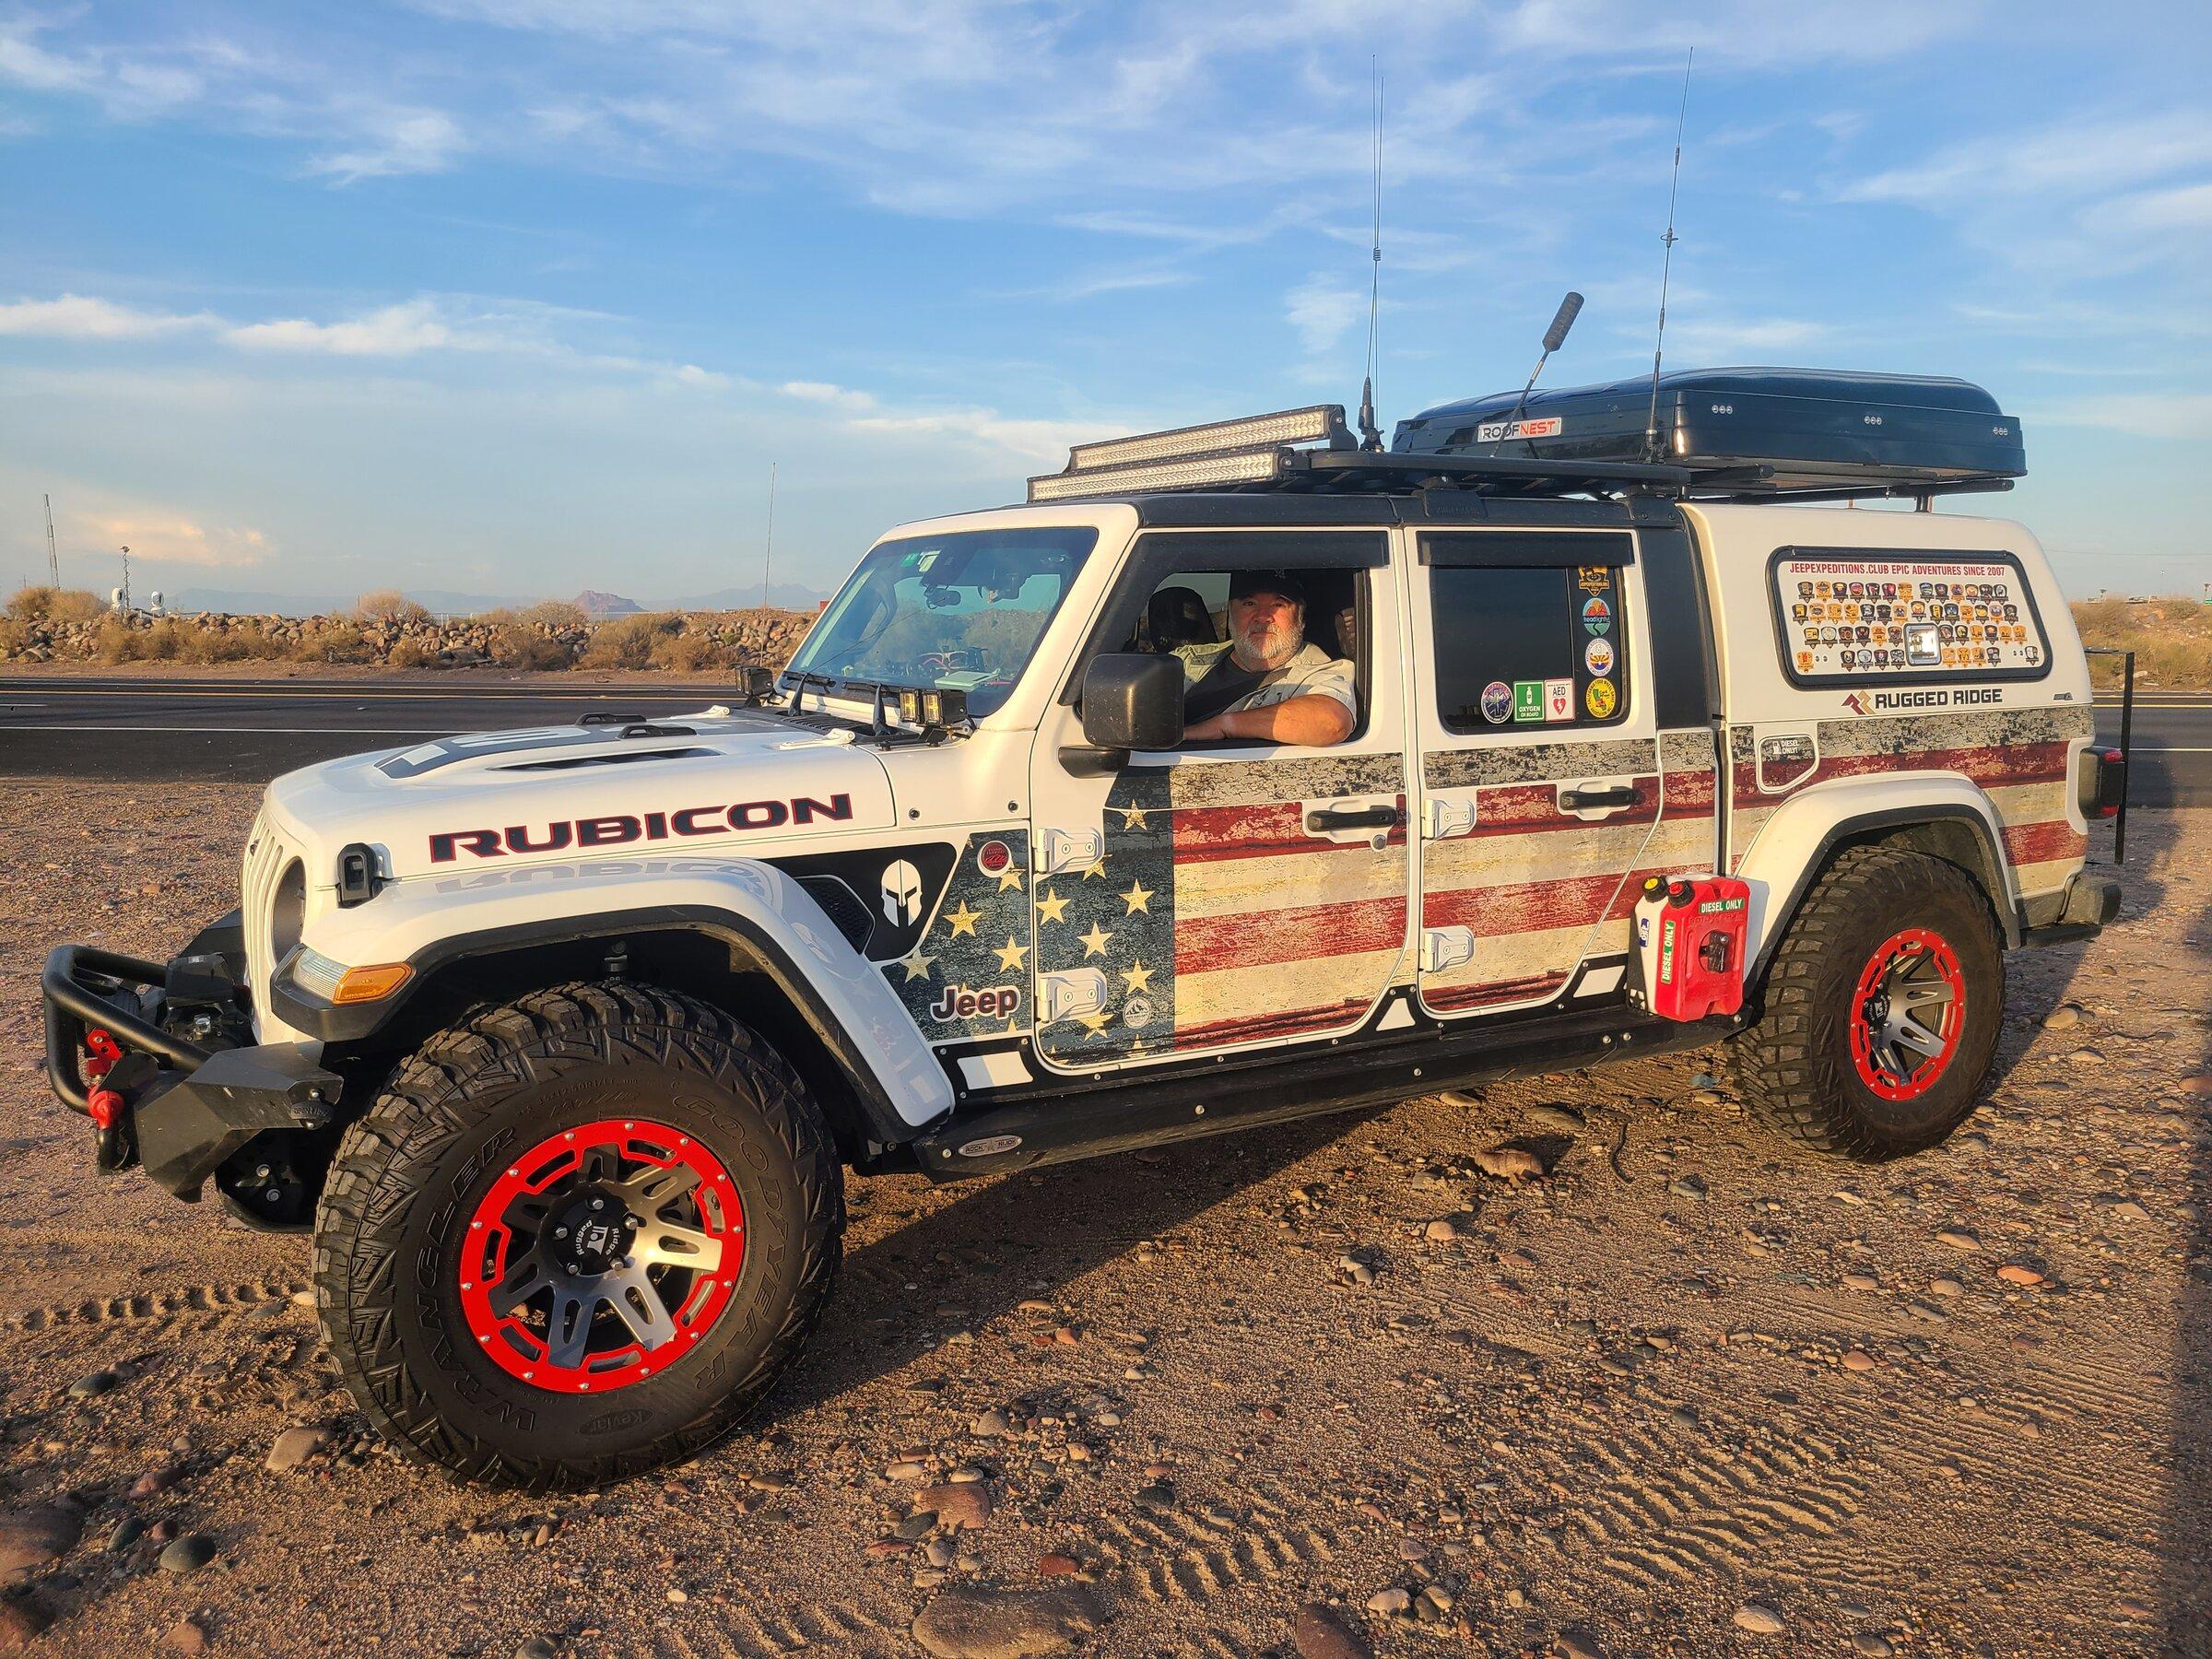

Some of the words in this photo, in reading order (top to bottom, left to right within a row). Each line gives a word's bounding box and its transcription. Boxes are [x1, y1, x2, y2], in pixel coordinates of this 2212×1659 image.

[1483, 421, 1555, 439] ROOFNEST
[1790, 563, 1888, 574] JEEPEXPEDITIONS.CLUB
[1891, 565, 1909, 574] EPIC
[1912, 566, 1961, 576] ADVENTURES
[1963, 567, 1985, 576] SINCE
[1987, 567, 2005, 576] 2007
[1553, 687, 1566, 696] AED
[1875, 691, 1947, 709] RUGGED
[1953, 688, 2003, 705] RIDGE
[429, 793, 853, 863] RUBICON
[1700, 902, 1724, 913] DIESEL
[1725, 899, 1743, 911] ONLY
[1665, 924, 1676, 947] ONLY
[1662, 951, 1672, 981] DIESEL
[932, 988, 1018, 1019] Jeep
[575, 1219, 593, 1255] Rugged
[605, 1228, 620, 1255] Ridge
[673, 1093, 790, 1391] GOODYEAR
[415, 1126, 536, 1432] WRANGLER
